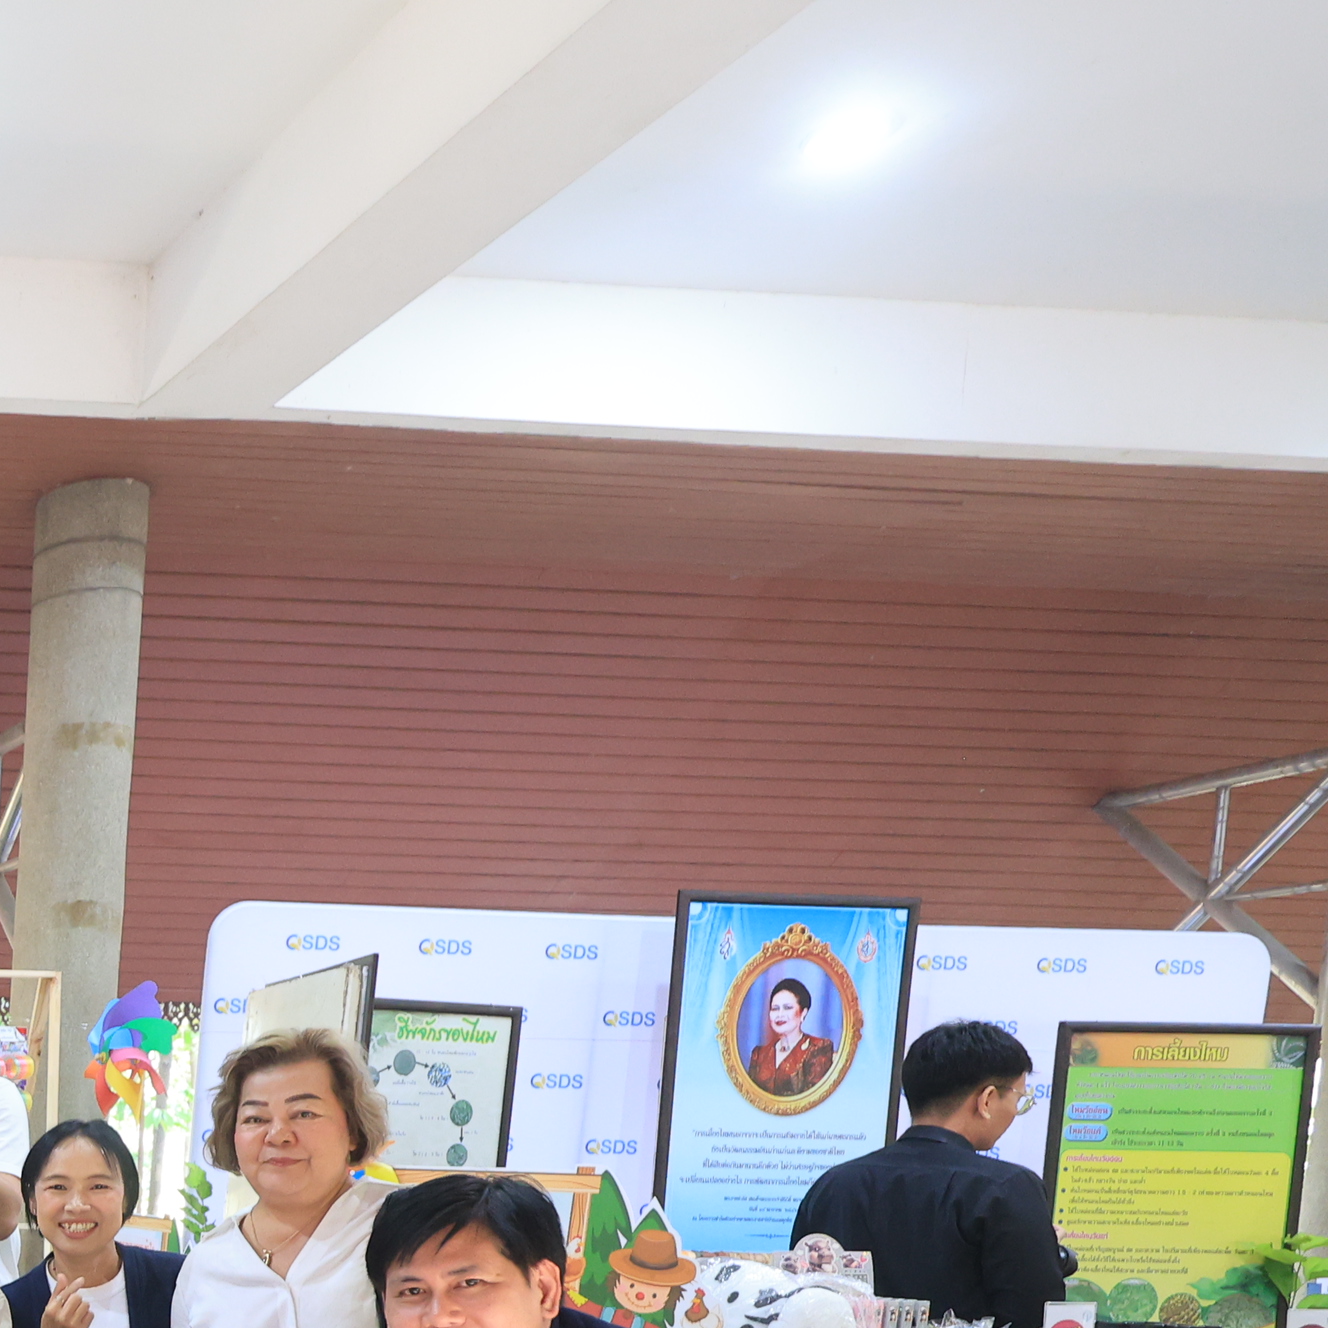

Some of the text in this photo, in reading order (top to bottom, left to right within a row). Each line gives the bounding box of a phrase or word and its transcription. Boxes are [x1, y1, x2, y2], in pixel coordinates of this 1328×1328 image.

[286, 934, 340, 951] QSDS
[418, 938, 472, 956] QSDS
[545, 943, 598, 961] QSDS
[916, 955, 968, 971] QSDS
[1037, 957, 1087, 974] QSDS
[1154, 959, 1205, 976] QSDS
[603, 1010, 656, 1027] QSDS
[1132, 1038, 1230, 1062] การเลี้ยงไหม
[530, 1073, 583, 1089] QSDS
[585, 1138, 637, 1155] QSDS
